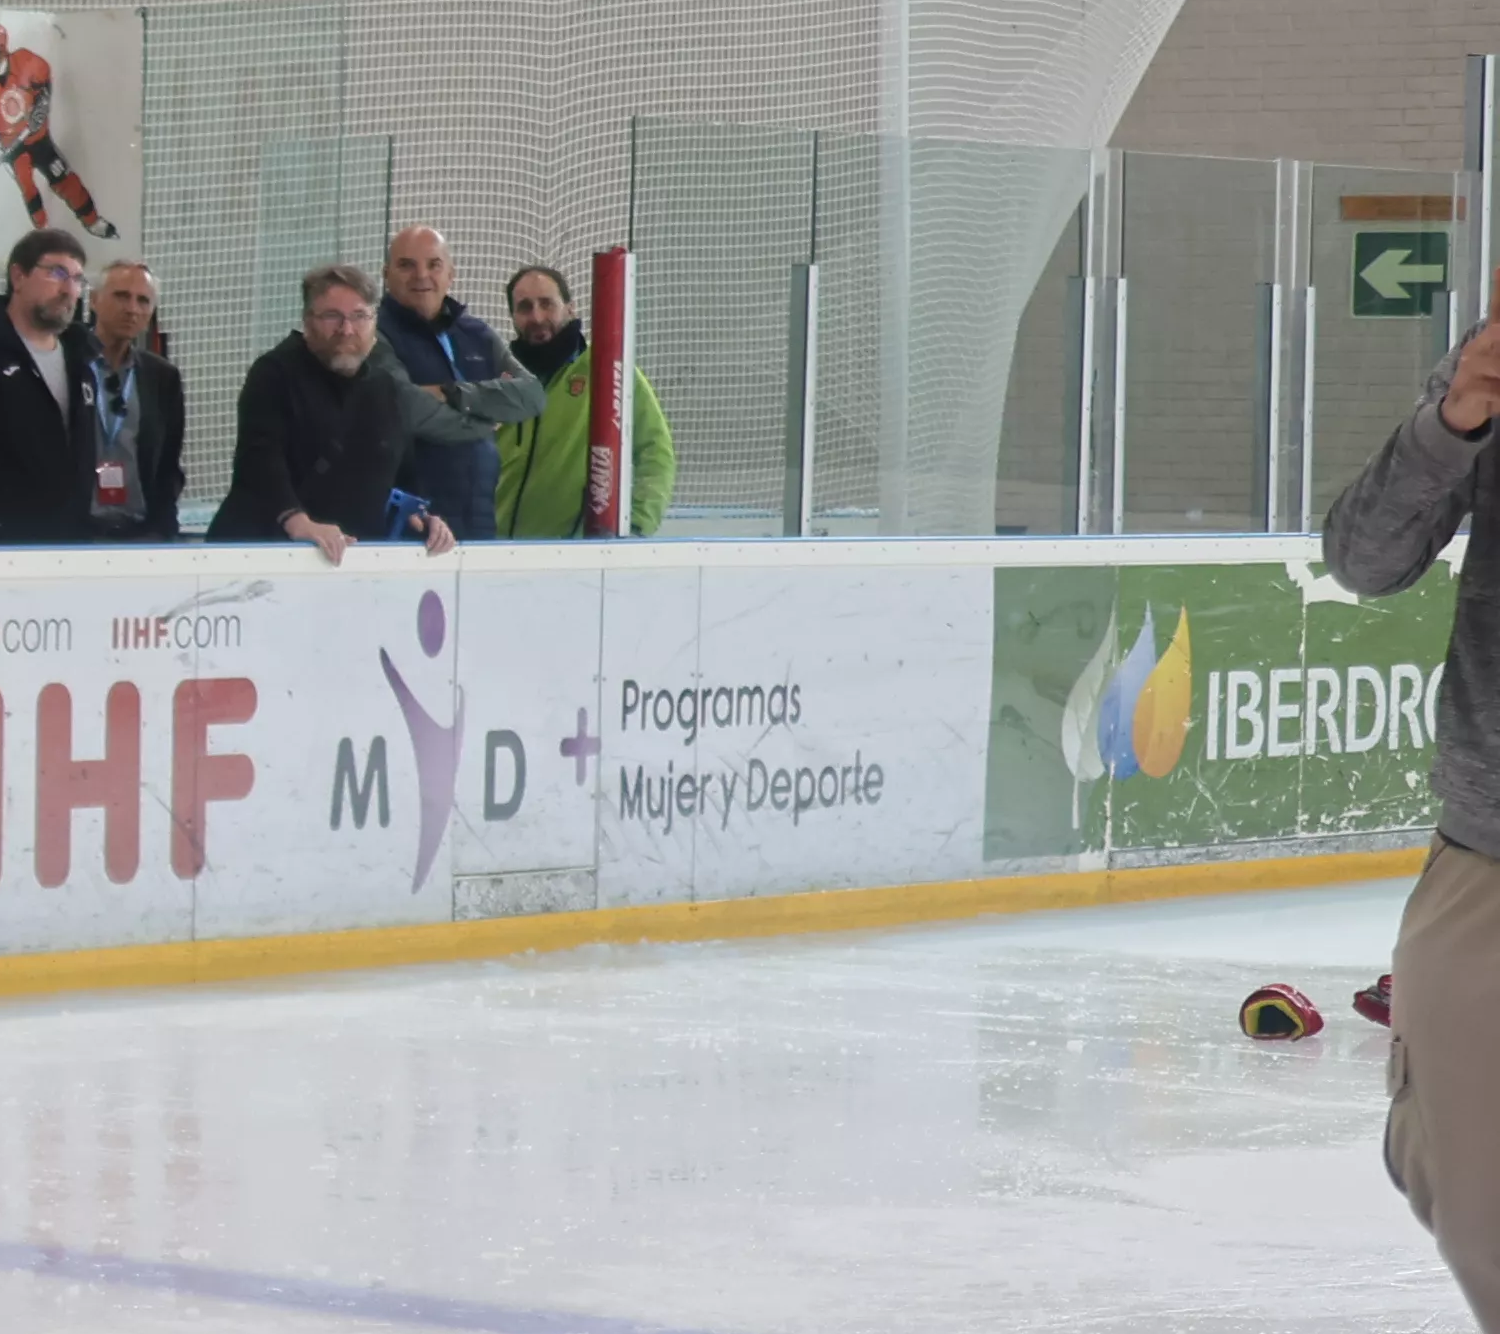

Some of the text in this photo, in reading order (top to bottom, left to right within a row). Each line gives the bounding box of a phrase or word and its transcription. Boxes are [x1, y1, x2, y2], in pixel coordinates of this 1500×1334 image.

[111, 614, 242, 650] IIHF.com
[621, 678, 801, 746] Programas
[618, 749, 885, 835] Mujer y Deporte
